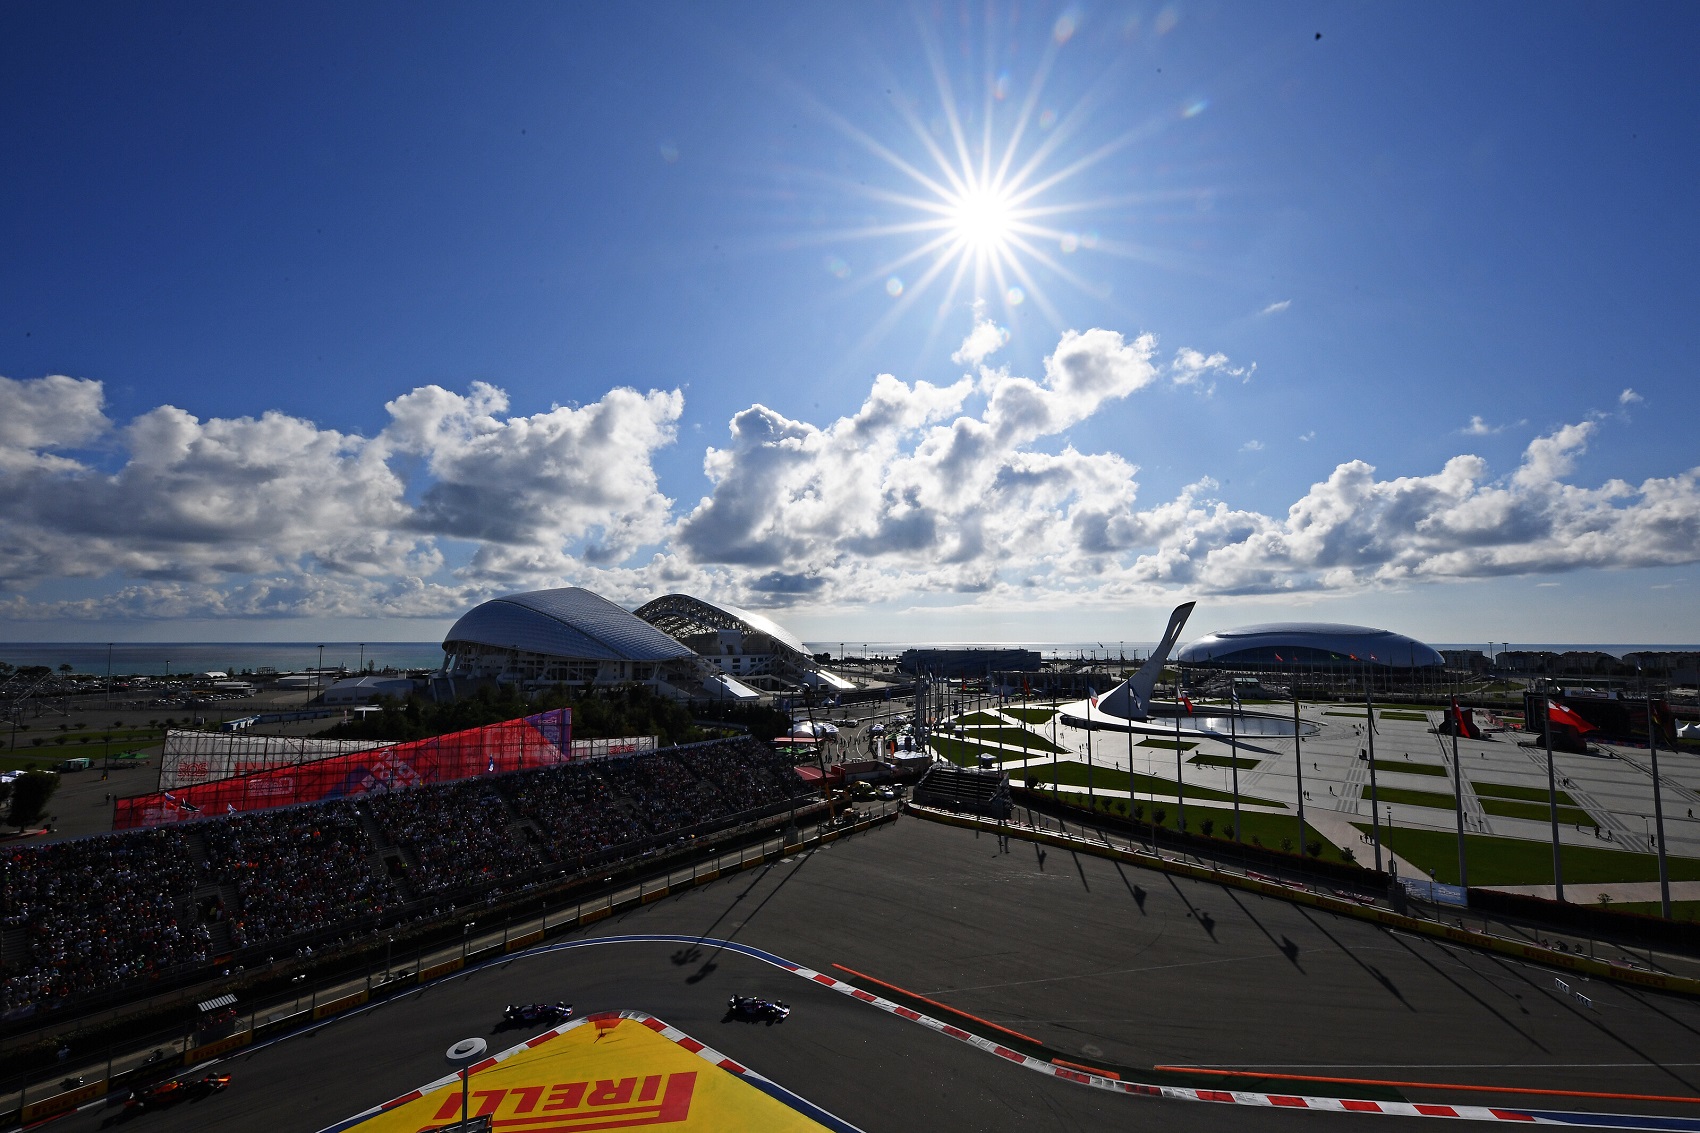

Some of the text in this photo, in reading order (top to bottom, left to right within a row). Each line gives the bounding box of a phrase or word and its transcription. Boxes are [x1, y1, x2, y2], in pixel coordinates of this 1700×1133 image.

[1262, 884, 1294, 900] PIRELLI
[1316, 895, 1353, 914] PIRELLI
[1378, 912, 1418, 930] PIRELLI
[1446, 928, 1492, 947] PIRELLI
[1524, 946, 1574, 967] PIRELLI
[424, 961, 459, 981] PIRELLI
[1610, 967, 1666, 988] PIRELLI
[320, 994, 362, 1017] PIRELLI
[192, 1034, 245, 1061] PIRELLI
[32, 1085, 98, 1118] PIRELLI
[416, 1071, 698, 1133] PIRELLI
